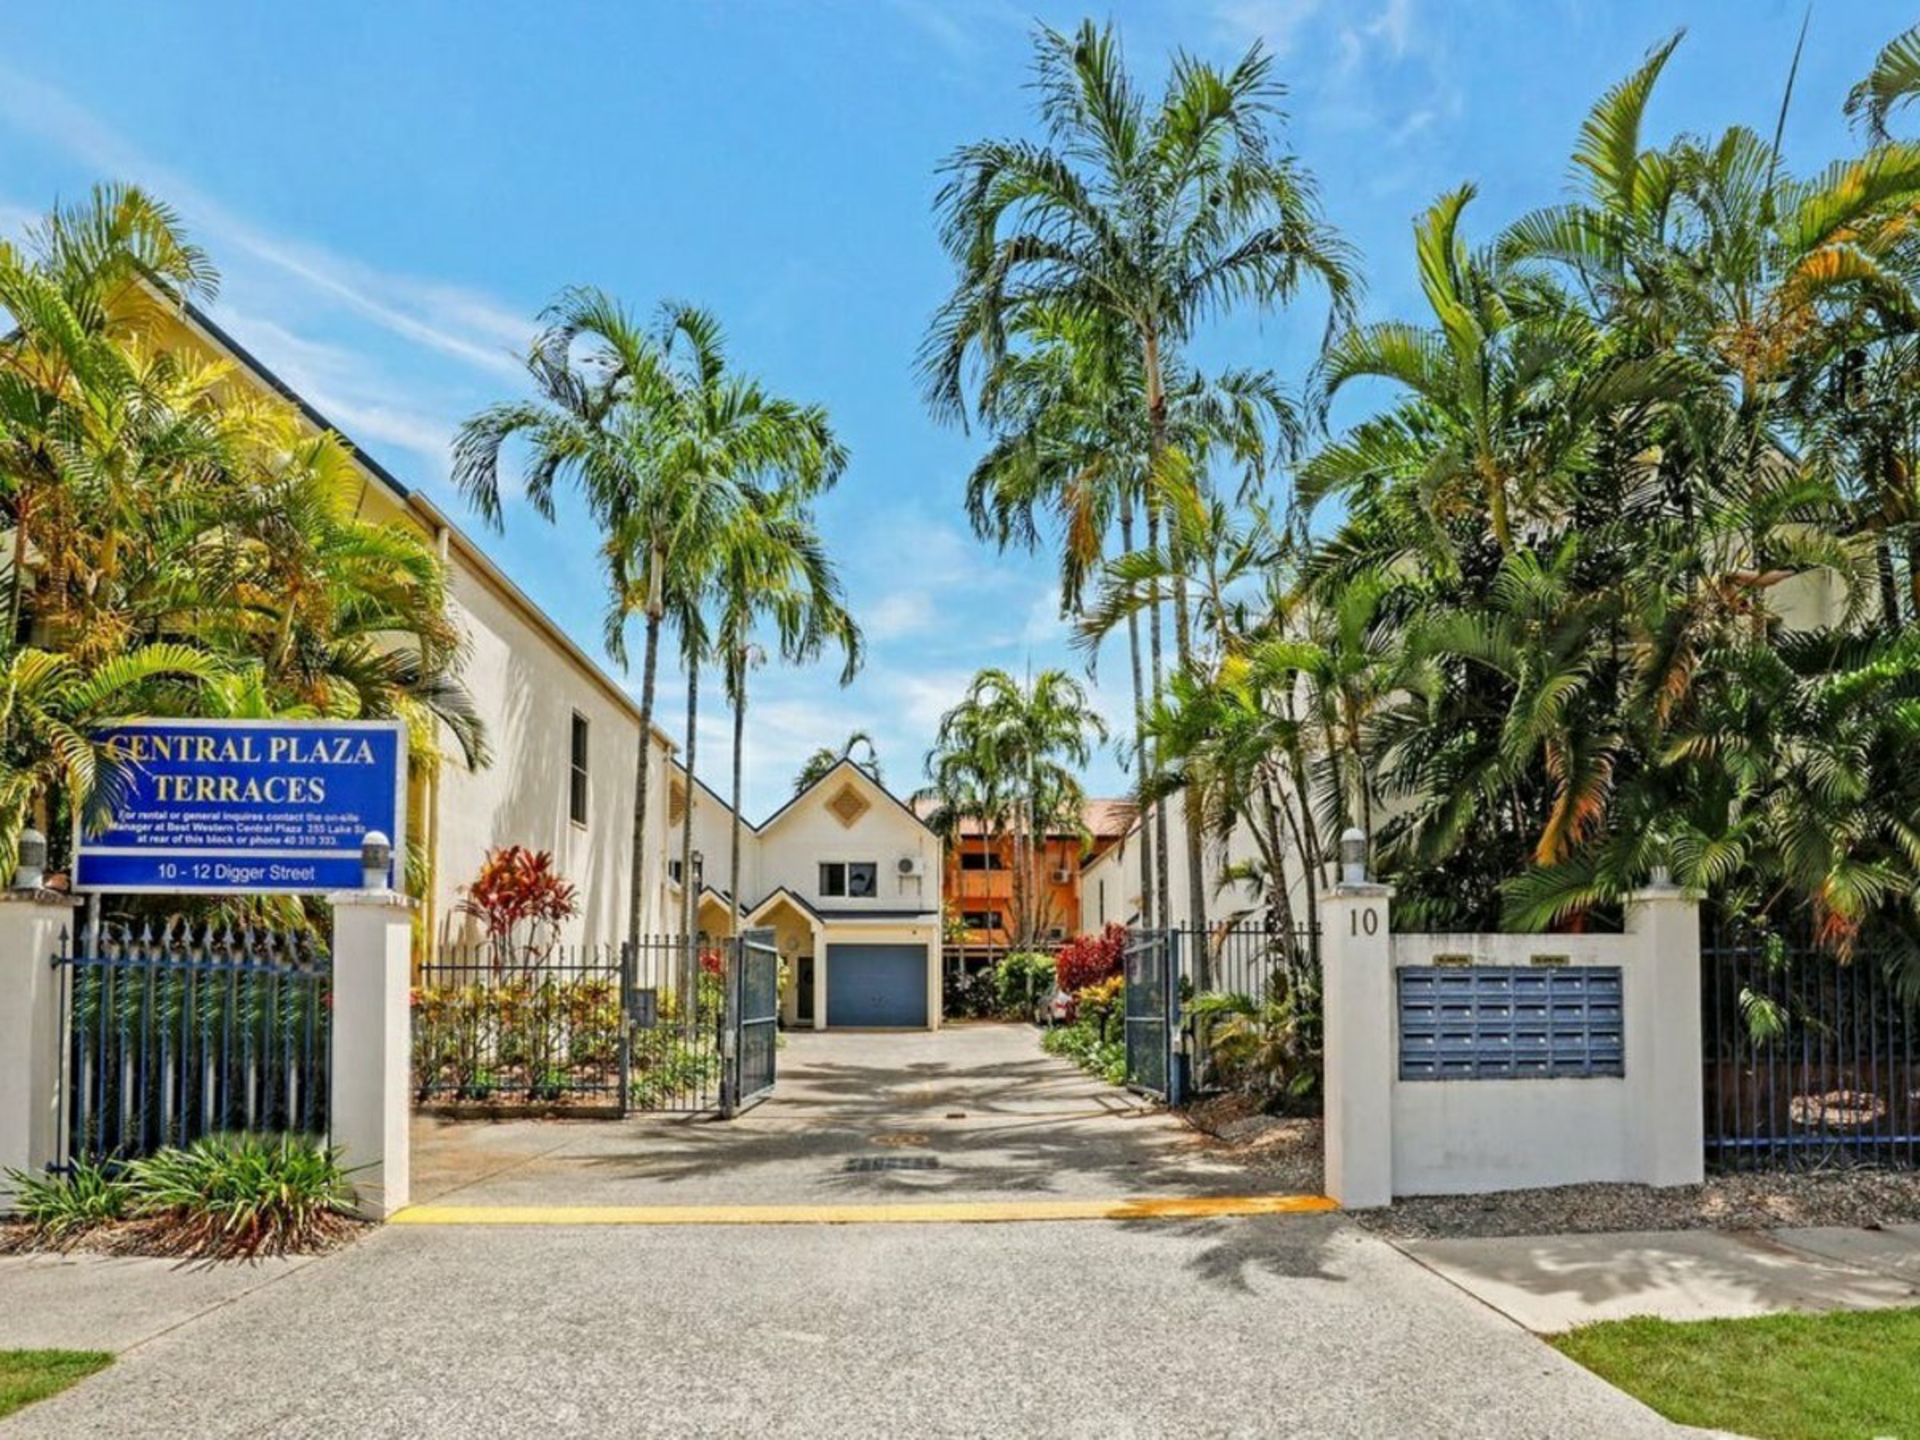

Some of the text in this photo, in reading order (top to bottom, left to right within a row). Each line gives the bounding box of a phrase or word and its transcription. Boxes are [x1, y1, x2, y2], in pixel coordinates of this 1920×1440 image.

[106, 734, 376, 764] CENTRAL PLAZA
[152, 775, 326, 804] TERRACES
[138, 811, 167, 821] rental
[169, 812, 180, 821] or
[183, 811, 221, 823] general
[266, 812, 304, 822] contact
[306, 812, 321, 822] the
[154, 822, 164, 832] at
[167, 822, 190, 832] Best
[192, 822, 234, 832] Western
[236, 823, 272, 833] Central
[275, 823, 302, 833] Plaza
[137, 834, 147, 844] at
[149, 835, 170, 844] rear
[171, 834, 182, 844] of
[184, 834, 204, 844] this
[206, 834, 234, 844] block
[236, 836, 247, 845] or
[250, 835, 281, 847] phone
[158, 863, 177, 879] 10
[192, 863, 211, 879] 12
[214, 863, 265, 883] Digger
[269, 864, 316, 880] Street
[1350, 907, 1379, 937] 10
